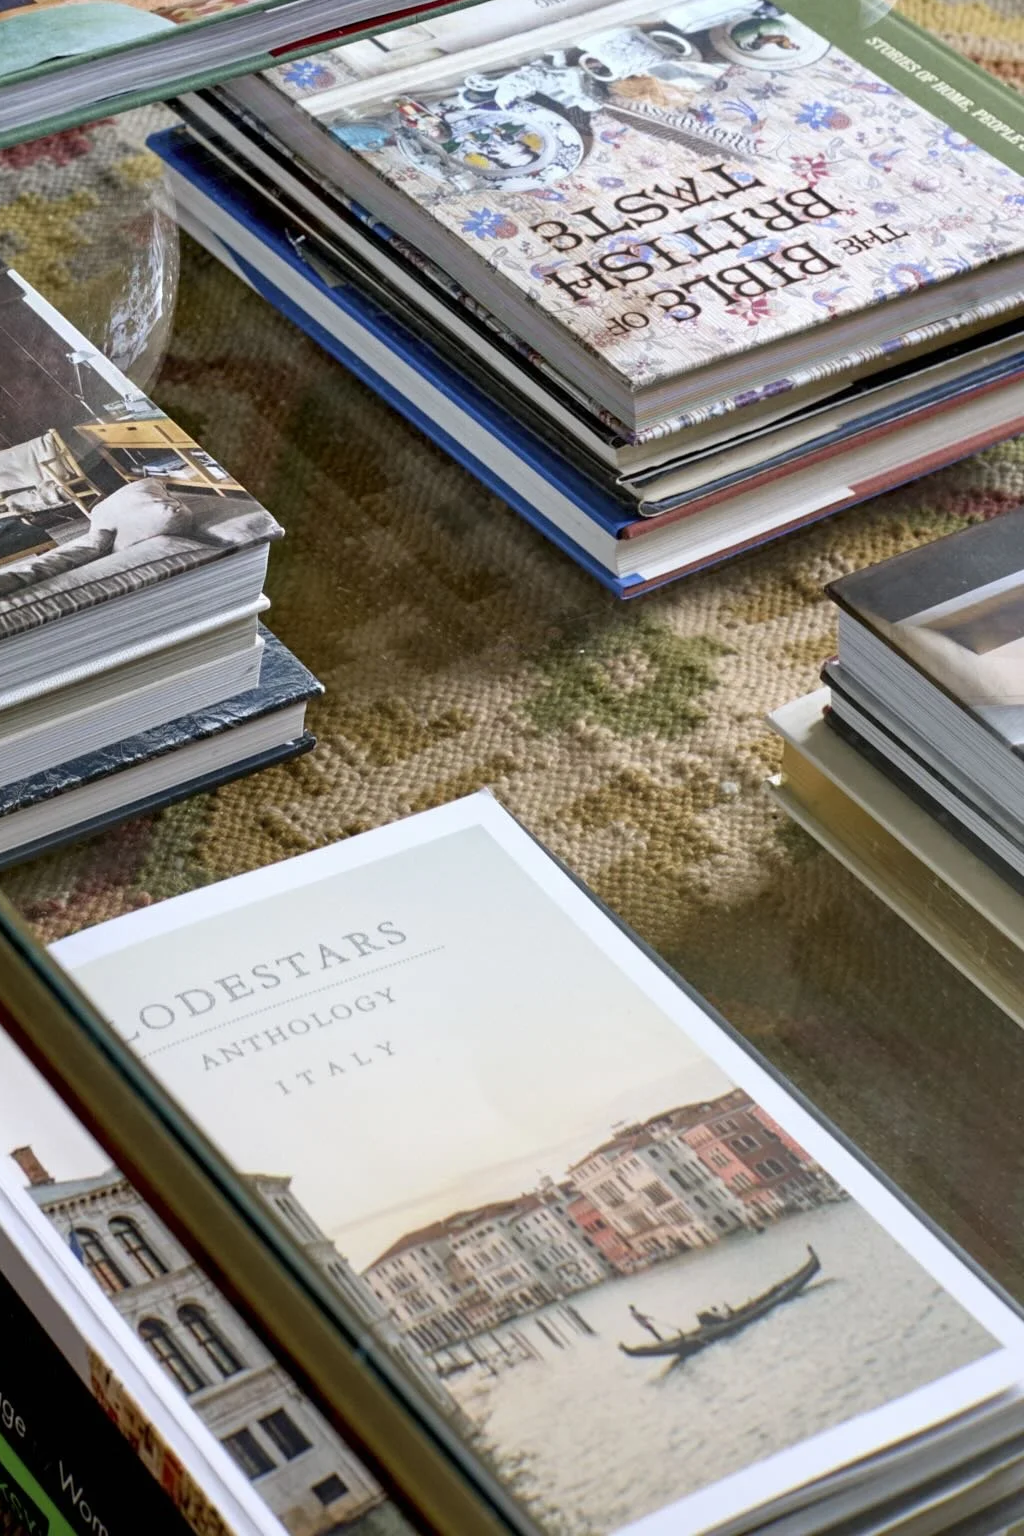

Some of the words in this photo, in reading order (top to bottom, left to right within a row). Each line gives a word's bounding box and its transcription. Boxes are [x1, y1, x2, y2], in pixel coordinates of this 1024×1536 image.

[864, 35, 922, 74] STORIES
[915, 68, 940, 86] OF
[930, 78, 974, 113] HOME,
[970, 107, 1019, 147] PEOPLE
[529, 162, 766, 253] TASTE
[544, 185, 845, 302] BRITISH
[832, 221, 911, 257] THE
[604, 311, 650, 337] OF
[647, 239, 842, 324] BIBLE
[201, 986, 399, 1072] ANTHOLOGY
[275, 1040, 398, 1097] ITALY
